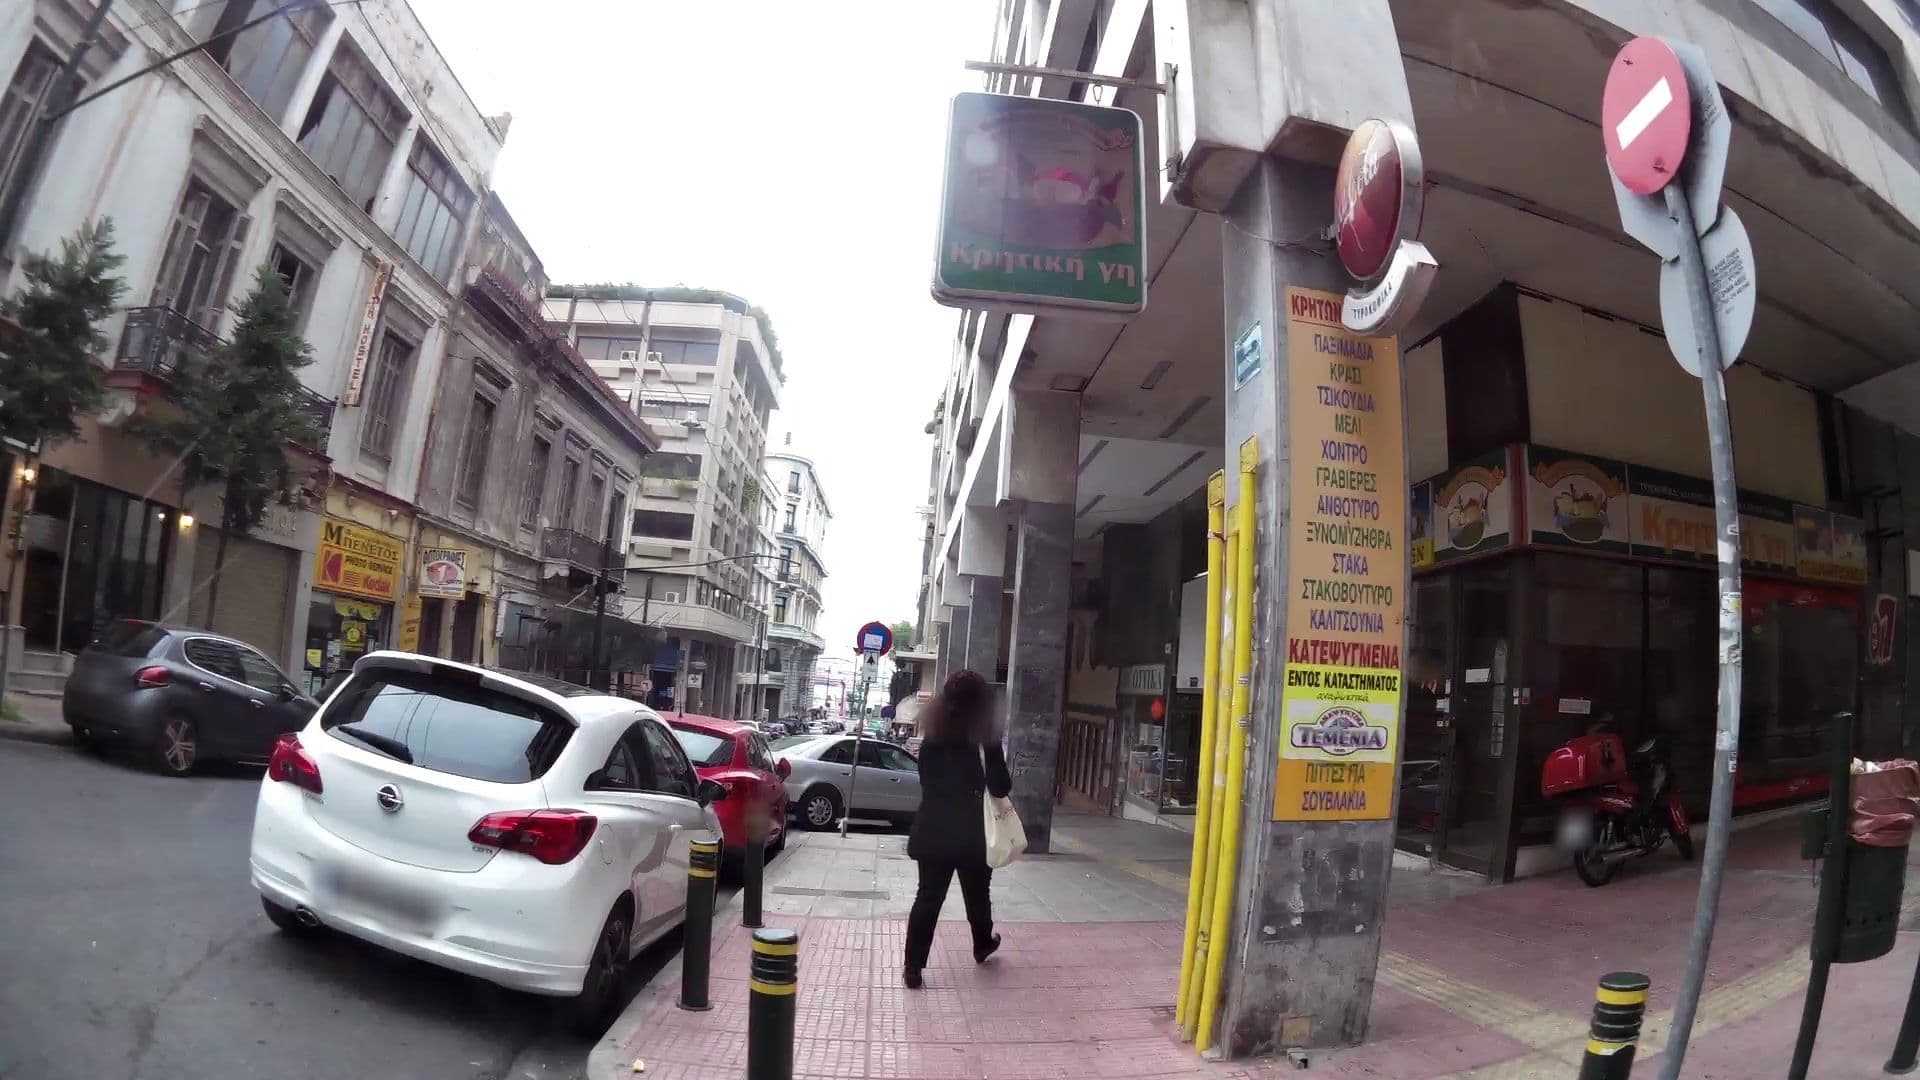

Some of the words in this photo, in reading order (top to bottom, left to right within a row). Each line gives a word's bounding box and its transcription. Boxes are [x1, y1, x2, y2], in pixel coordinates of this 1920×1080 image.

[1098, 262, 1136, 287] γη
[350, 324, 372, 390] HOSTEL
[1314, 333, 1374, 363] ΠΑΞΙΜΑΔΙΑ
[1329, 362, 1362, 384] ΚΡΑΣΙ
[1316, 385, 1375, 412] ΤΣΙΚΟΥΔΙΑ
[1335, 412, 1362, 435] ΜΕΛΙ
[1321, 439, 1368, 465] ΧΟΝΤΡΟ
[1316, 466, 1377, 493] ΓΡΑΒΙΕΡΕΣ
[1317, 494, 1380, 521] ΑΝΘΟΤΥΡΟ
[1332, 552, 1369, 576] ΣΤΑΚΑ
[363, 575, 392, 593] Kodak
[1302, 578, 1393, 607] ΣΤΑΚΟΒΟΥΤΥΡΟ
[1310, 607, 1385, 633] ΚΑΛΙΤΣΟΥΝΙΑ
[1289, 638, 1400, 669] ΚΑΤΕΨΥΓΜΕΝΑ
[1288, 669, 1321, 688] ΕΝΤΟΣ
[1323, 671, 1398, 692] ΚΑΤΑΣΤΗΜΑΤΟΣ
[1302, 790, 1367, 812] ΣΟΥΒΛΑΚΙΑ
